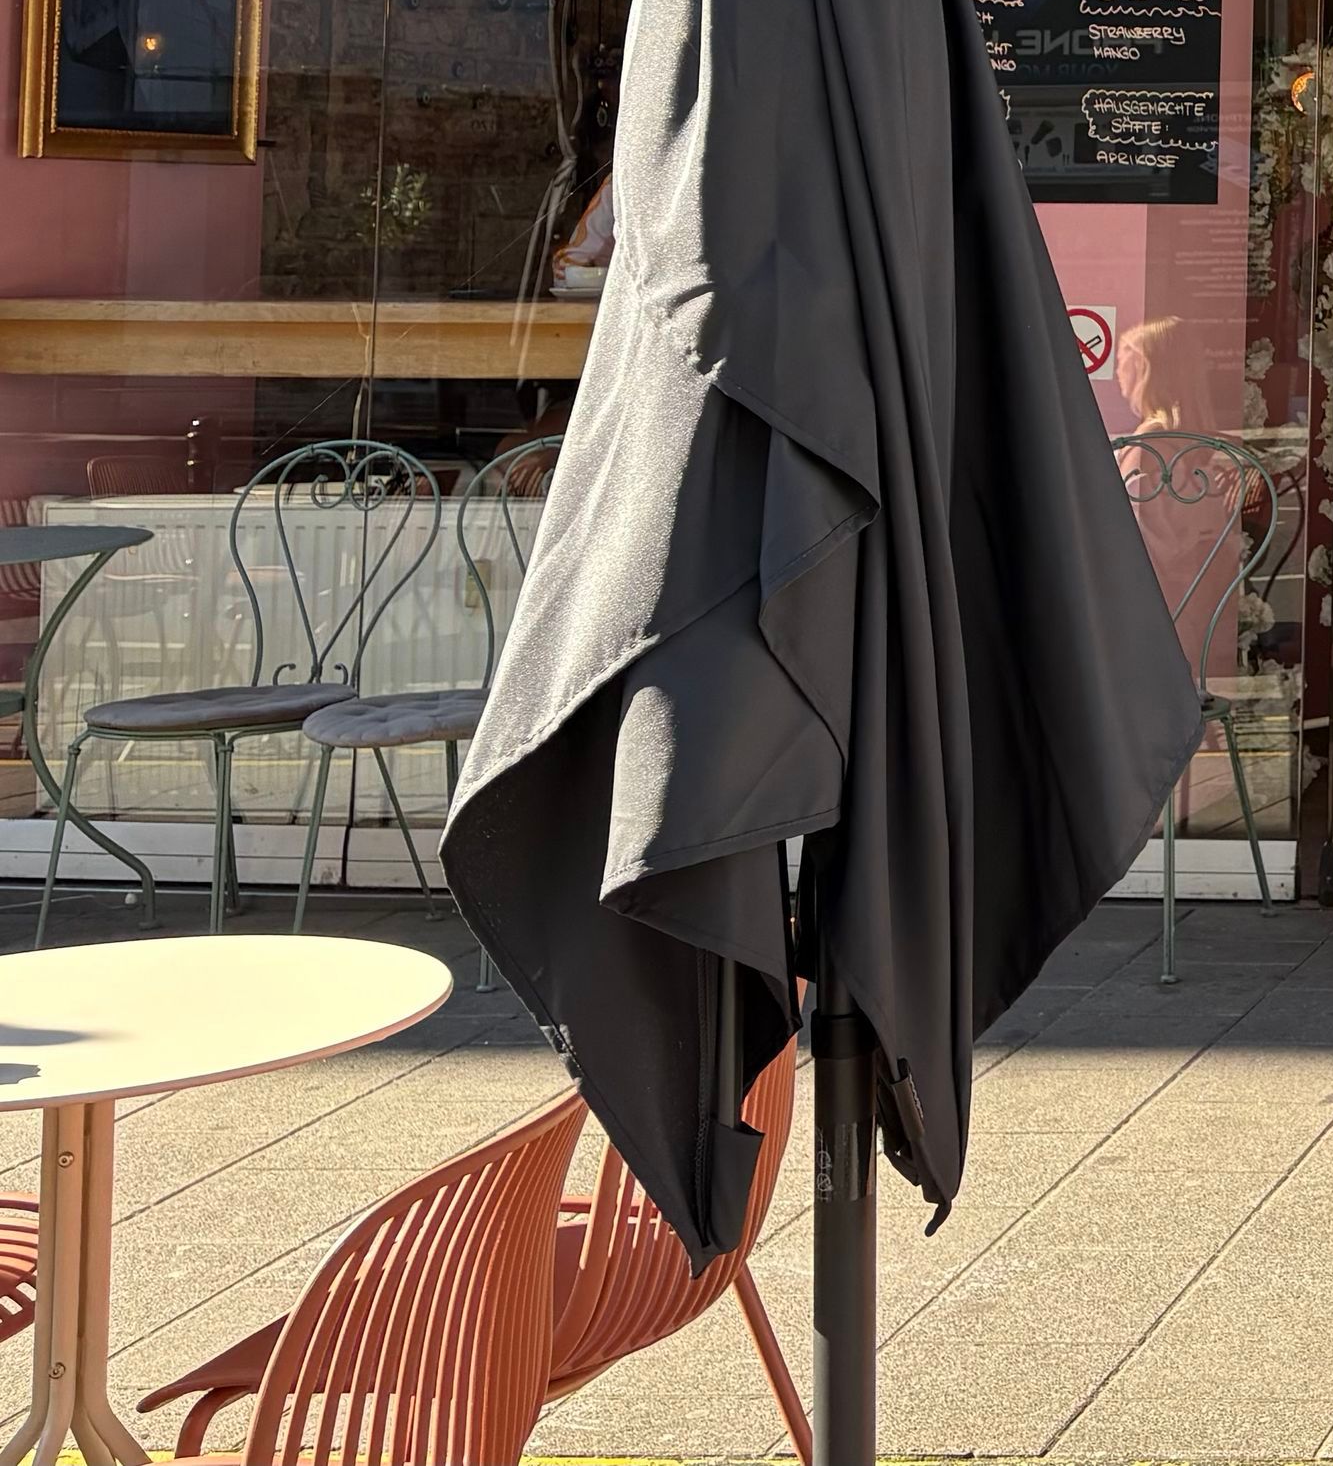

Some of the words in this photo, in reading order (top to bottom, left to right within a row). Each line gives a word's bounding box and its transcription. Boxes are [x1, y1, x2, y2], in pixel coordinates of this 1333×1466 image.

[1088, 24, 1186, 45] STRAWBERRY
[1093, 46, 1141, 61] MANGO
[1093, 97, 1207, 117] HAUSGEMACHTE
[1096, 150, 1180, 169] APRIKOSE
